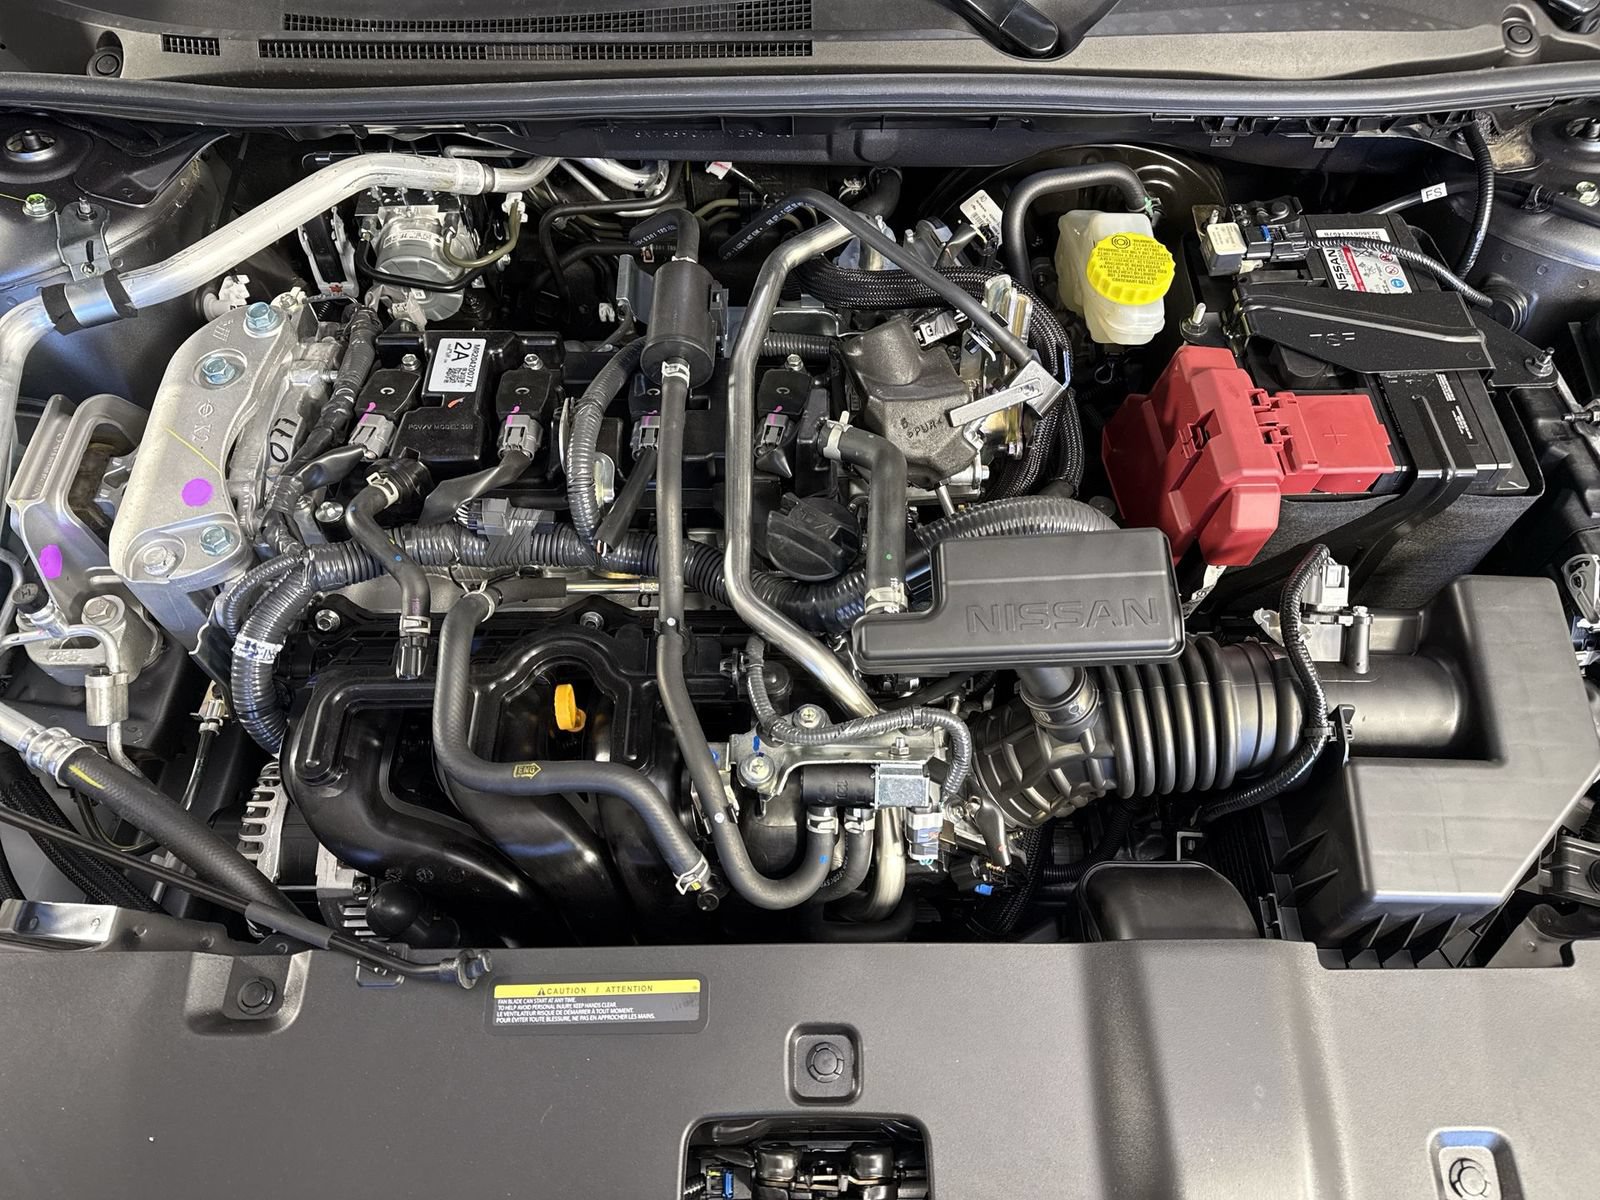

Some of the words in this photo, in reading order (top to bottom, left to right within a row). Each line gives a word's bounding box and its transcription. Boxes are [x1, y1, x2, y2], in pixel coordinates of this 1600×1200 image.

[1425, 187, 1443, 199] FS
[1326, 249, 1350, 290] NISSAN
[451, 341, 472, 362] 2A
[966, 598, 1160, 632] NISSAN
[547, 987, 586, 995] CAUTION
[605, 985, 653, 993] ATTENTION
